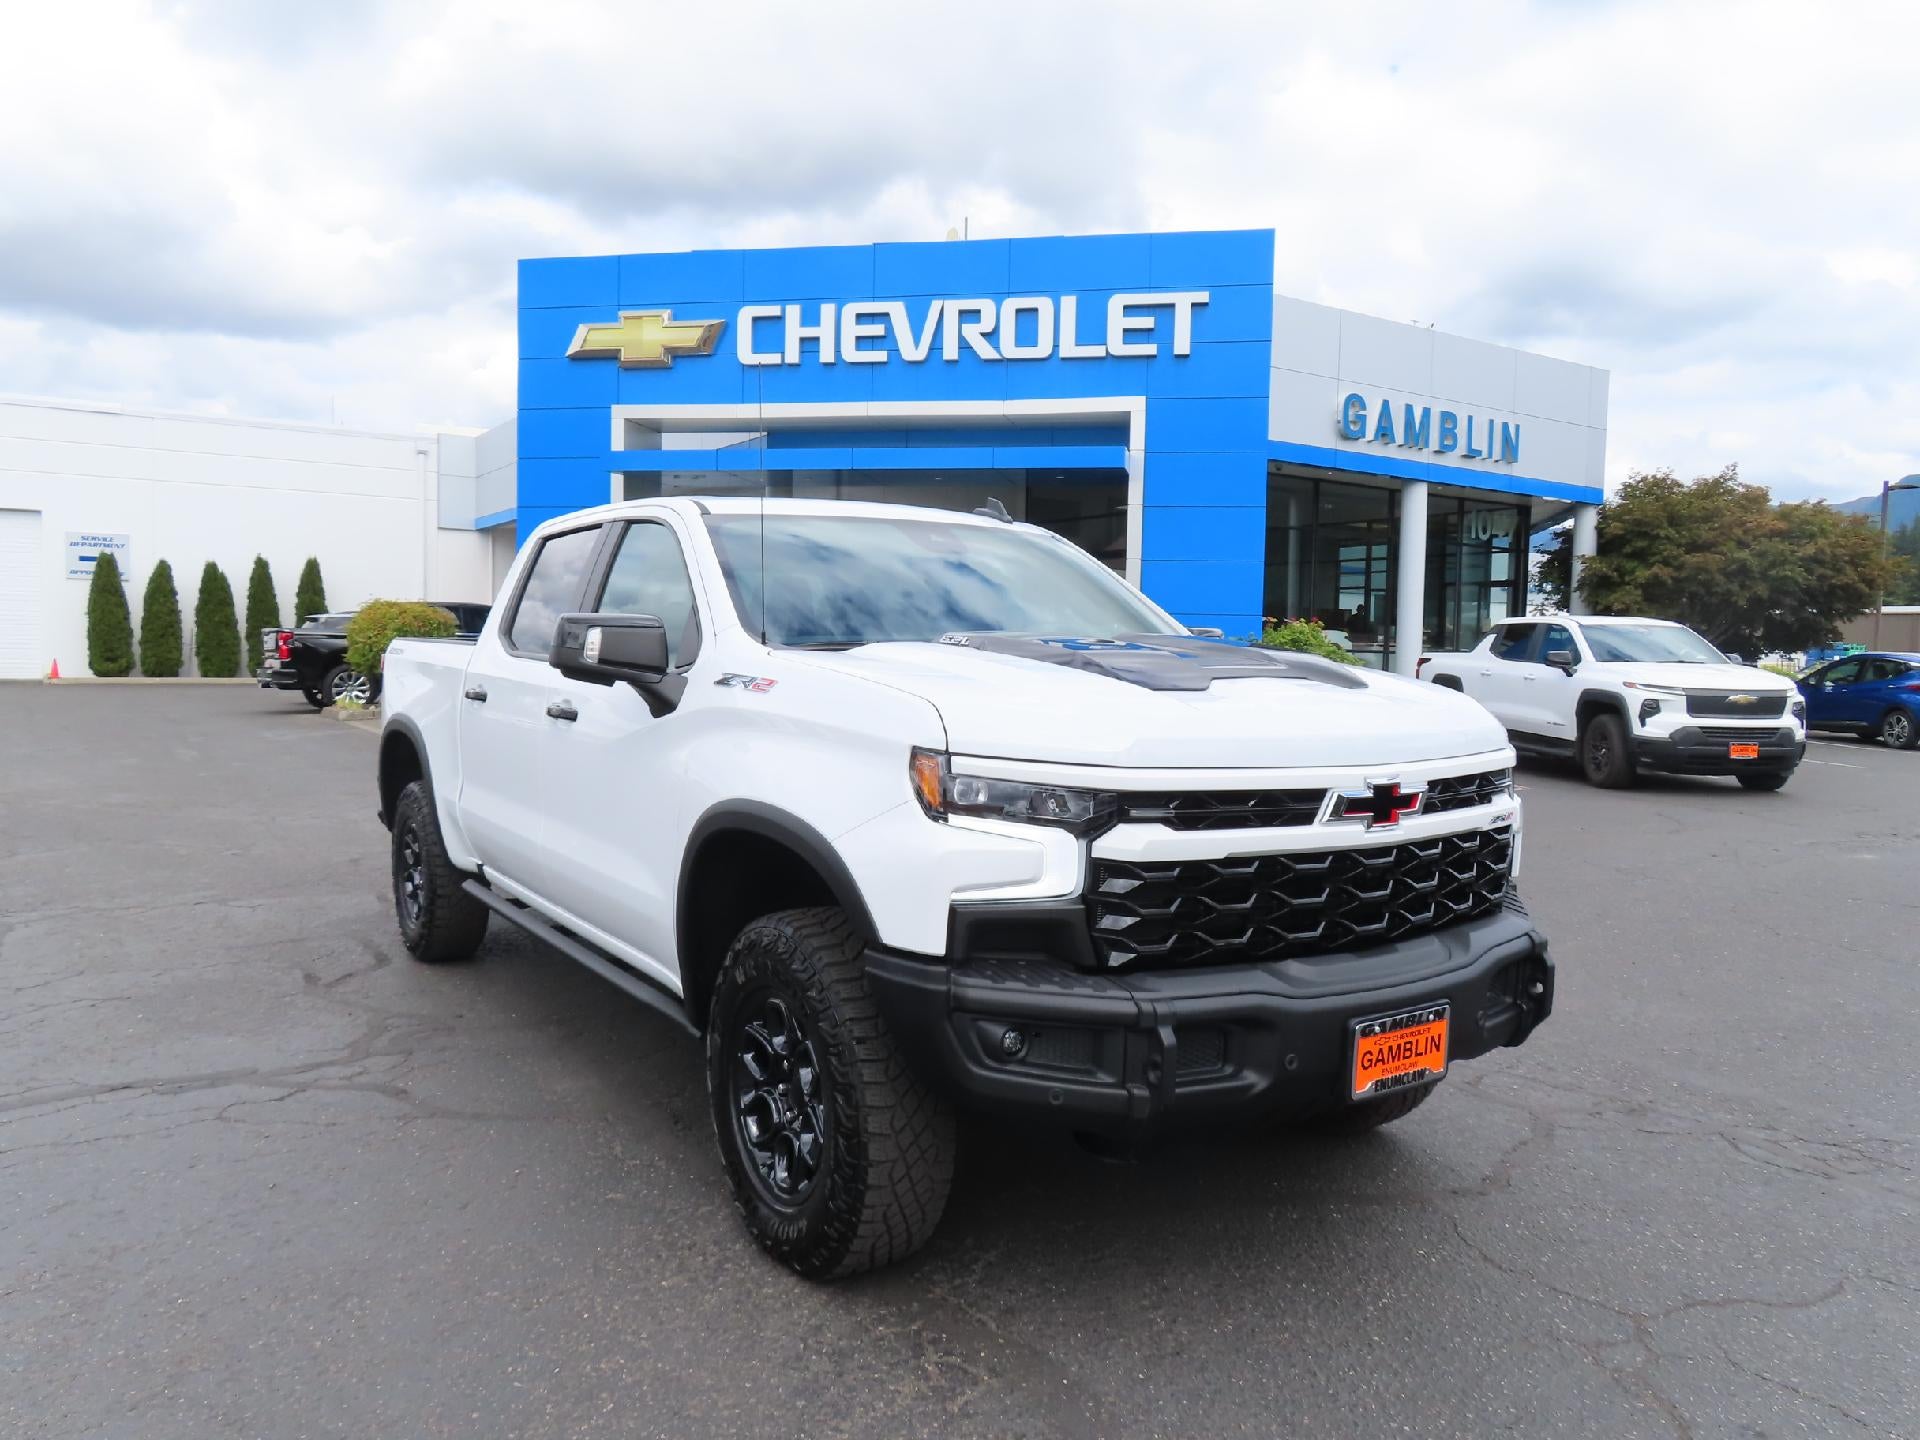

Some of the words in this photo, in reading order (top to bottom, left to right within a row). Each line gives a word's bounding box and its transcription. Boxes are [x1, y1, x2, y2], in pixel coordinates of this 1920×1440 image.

[737, 290, 1210, 366] CHEVROLET
[1340, 392, 1520, 464] GAMBLIN
[69, 541, 126, 549] DEPARTMENT
[80, 535, 115, 543] SERVICE
[1392, 1027, 1431, 1042] CHEVROLET
[1361, 1033, 1442, 1070] GAMBLIN
[1381, 1061, 1419, 1076] ENUMCLAW
[1374, 1068, 1427, 1092] ENUMCLAW
